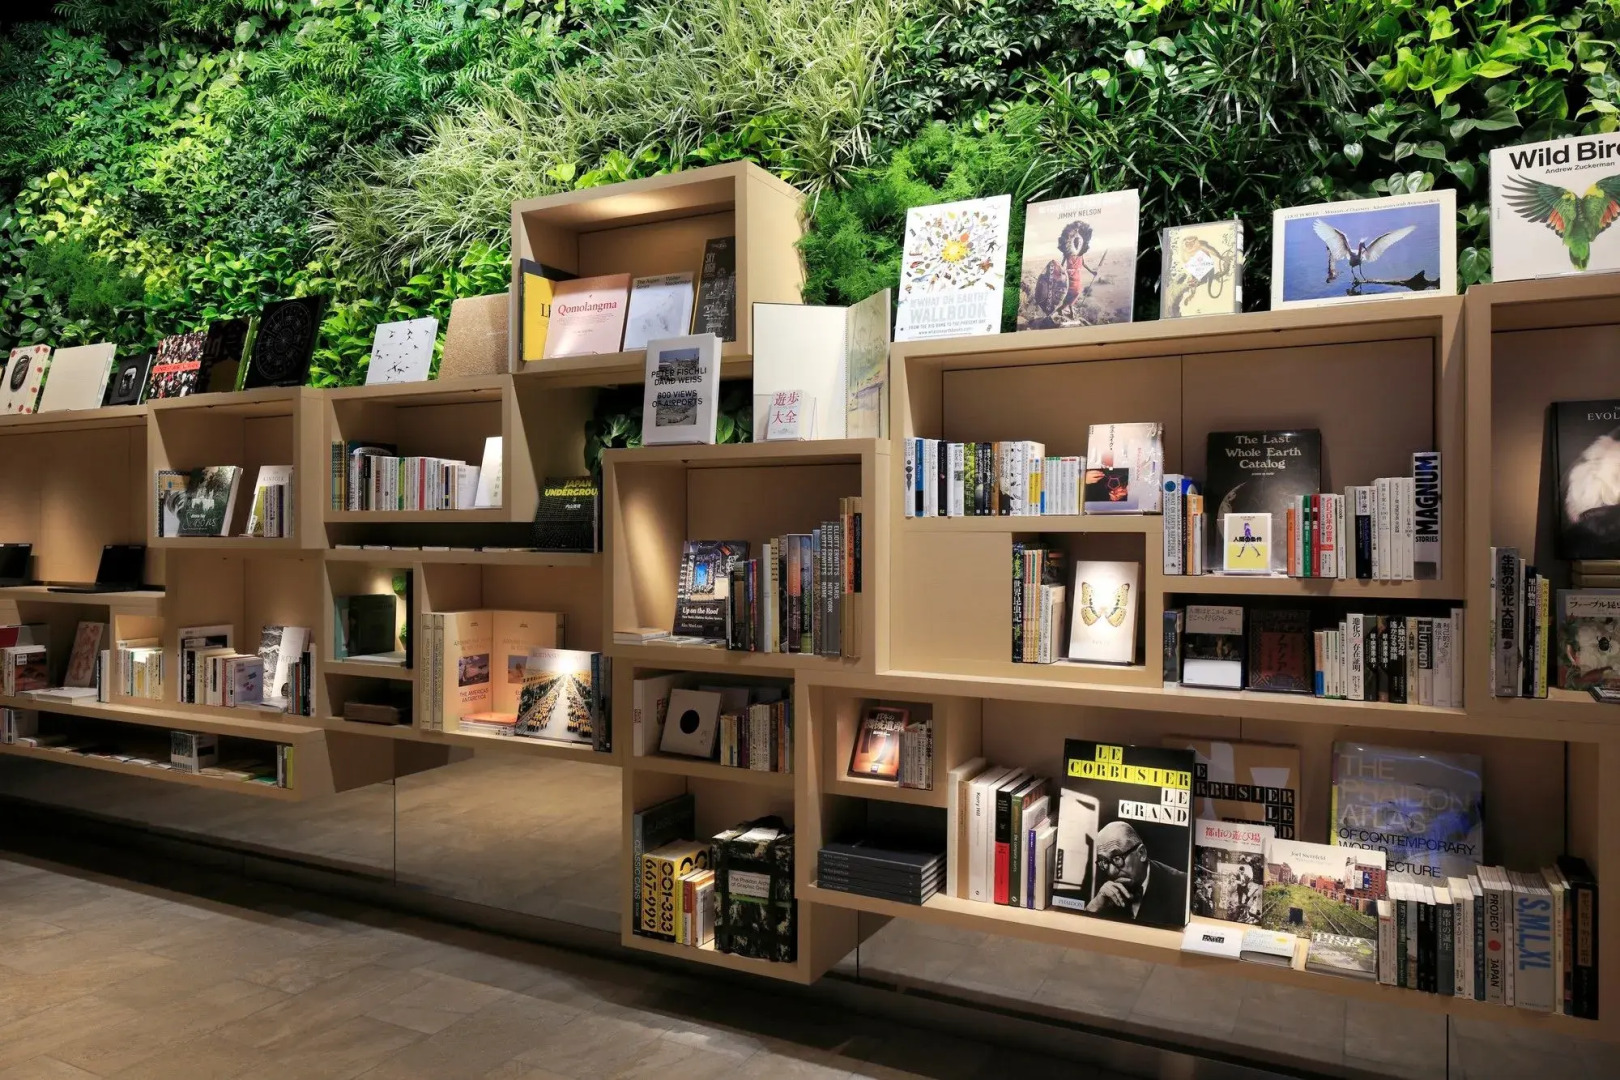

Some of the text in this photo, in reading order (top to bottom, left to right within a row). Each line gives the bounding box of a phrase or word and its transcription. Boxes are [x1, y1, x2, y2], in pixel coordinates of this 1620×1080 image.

[1509, 144, 1569, 170] Wild
[1545, 161, 1615, 174] Andrew Zuckerman
[1057, 212, 1077, 220] JIMMY
[1078, 208, 1102, 217] NELSON
[558, 300, 617, 316] Qomolangma
[910, 303, 987, 323] WALLBOOK
[651, 367, 707, 378] PETER FISCHLI
[654, 376, 703, 386] DAVID WEISS
[673, 390, 698, 398] VIEWS
[774, 391, 799, 406] 遊歩
[663, 398, 703, 407] AIRPORTS
[772, 410, 797, 424] 大全
[1587, 412, 1620, 421] EVOL
[1235, 435, 1291, 444] The Last
[1225, 447, 1302, 458] Whole Earth
[1239, 459, 1286, 469] Catalog
[564, 480, 592, 489] JAPAN
[1414, 455, 1439, 535] MAGNUM
[1501, 555, 1515, 640] 生物の進化大図鑑
[682, 606, 689, 615] Up
[1419, 624, 1432, 668] Human
[1352, 643, 1360, 672] 存在証明
[462, 695, 487, 703] ANTARCTICA
[468, 688, 489, 696] AMERICAS
[1098, 746, 1121, 761] LE
[1070, 762, 1188, 787] CORBUSIER
[1341, 754, 1396, 780] THE
[1164, 790, 1188, 805] LE
[1341, 779, 1469, 812] PHAIDON
[1120, 803, 1187, 822] GRAND
[1268, 806, 1293, 822] LE
[1340, 804, 1426, 834] ATLAS
[1205, 826, 1261, 844] 都市の遊び場
[1339, 828, 1476, 856] OF CONTEMPORARY
[644, 859, 657, 929] 667-999
[661, 861, 674, 932] 001-333
[1490, 893, 1499, 934] PROJECT
[1490, 959, 1500, 988] JAPAN
